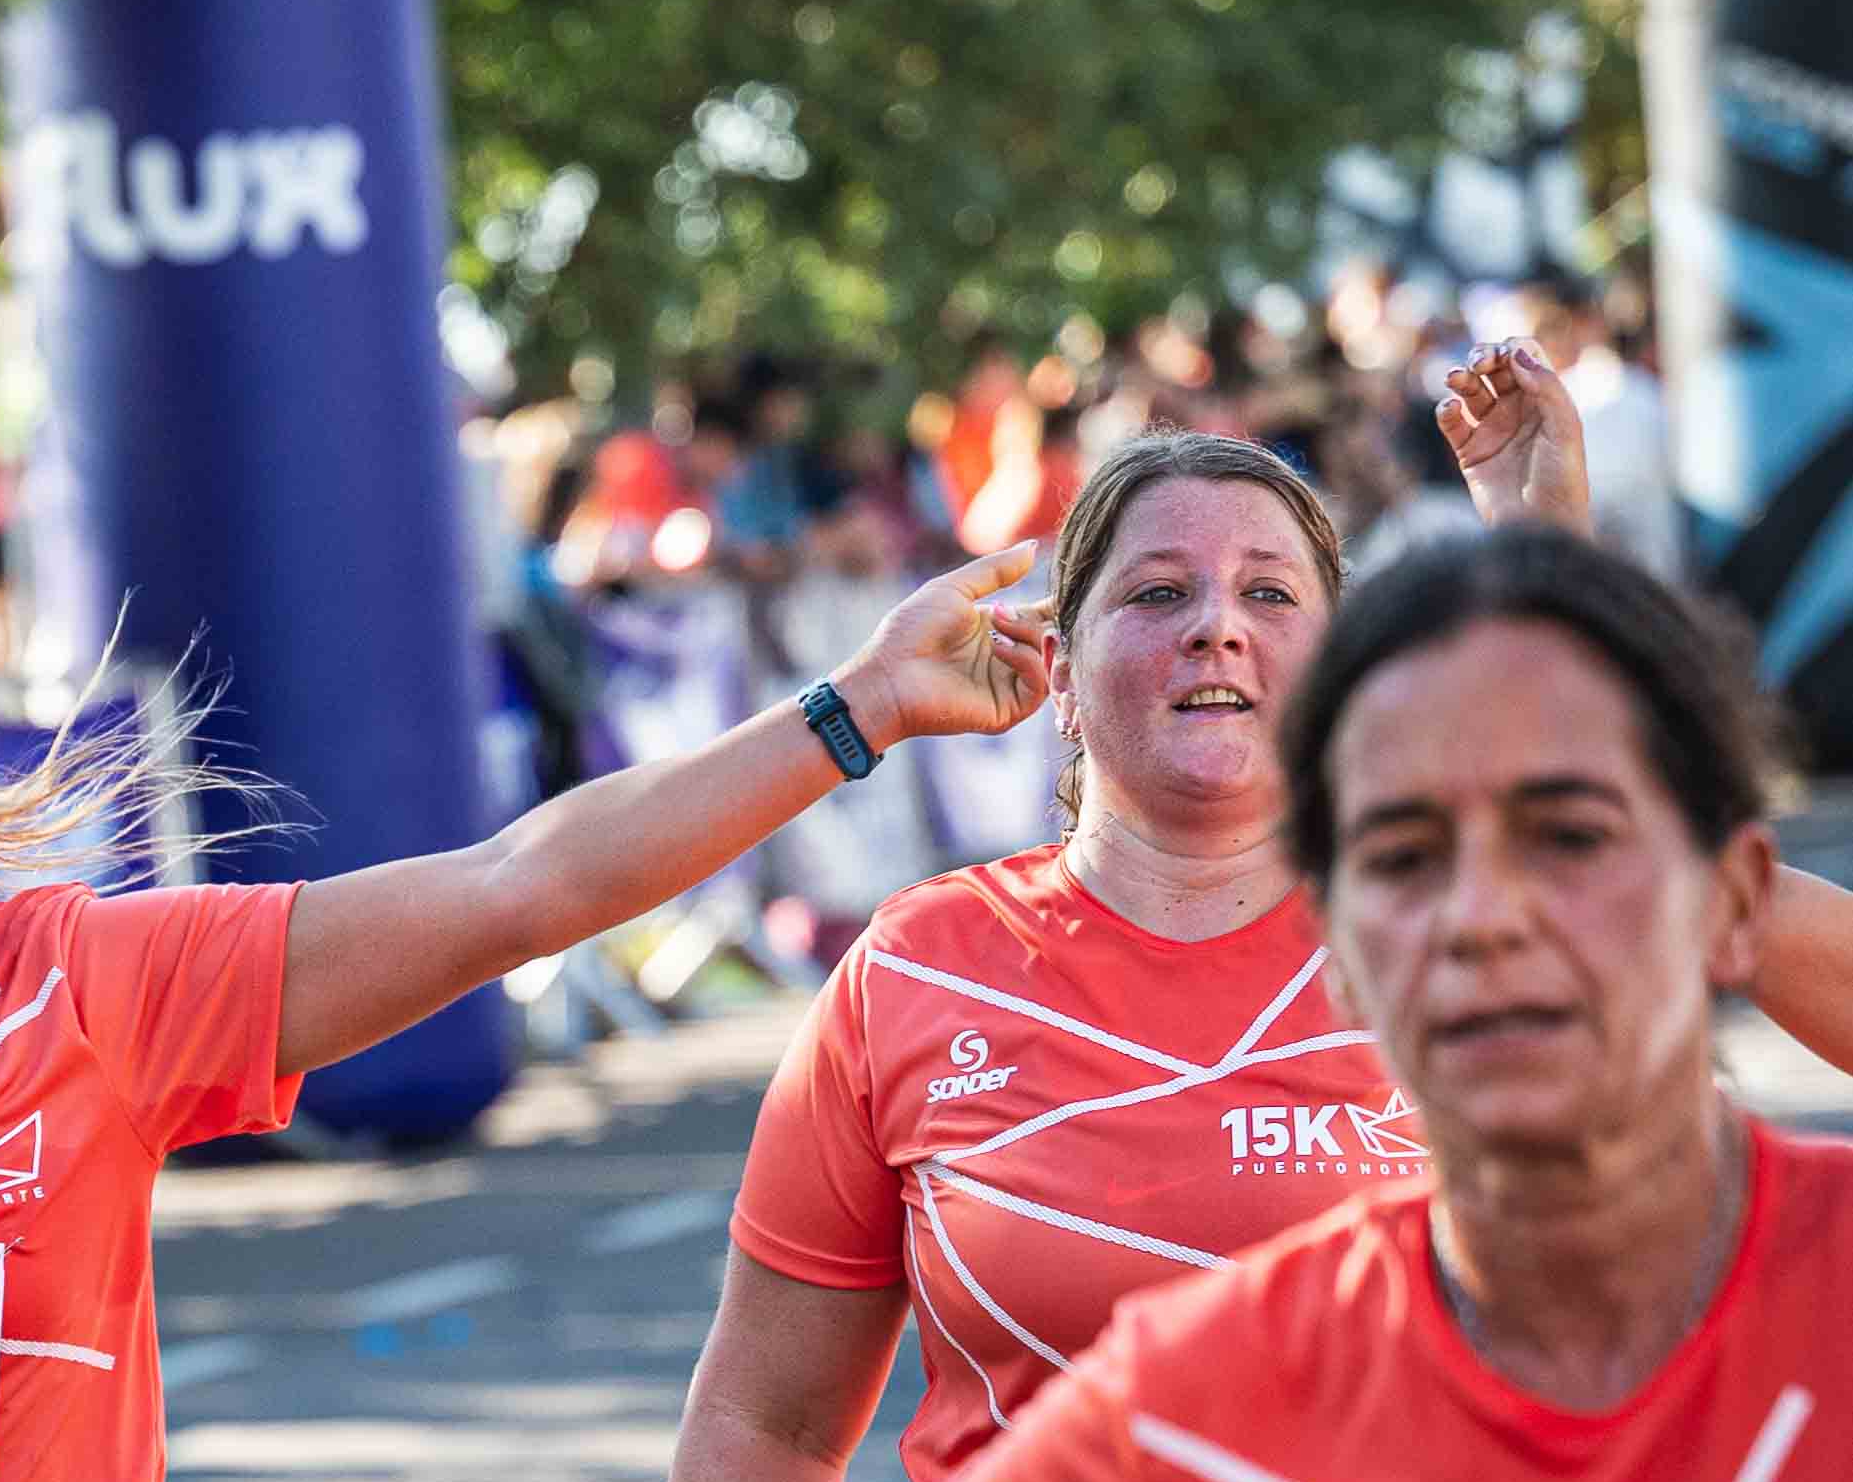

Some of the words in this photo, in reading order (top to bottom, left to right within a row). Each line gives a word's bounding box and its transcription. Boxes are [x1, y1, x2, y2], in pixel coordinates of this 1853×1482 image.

[1220, 1104, 1345, 1159] 15K
[1231, 1161, 1348, 1175] PUERTO
[1359, 1161, 1435, 1175] NORT
